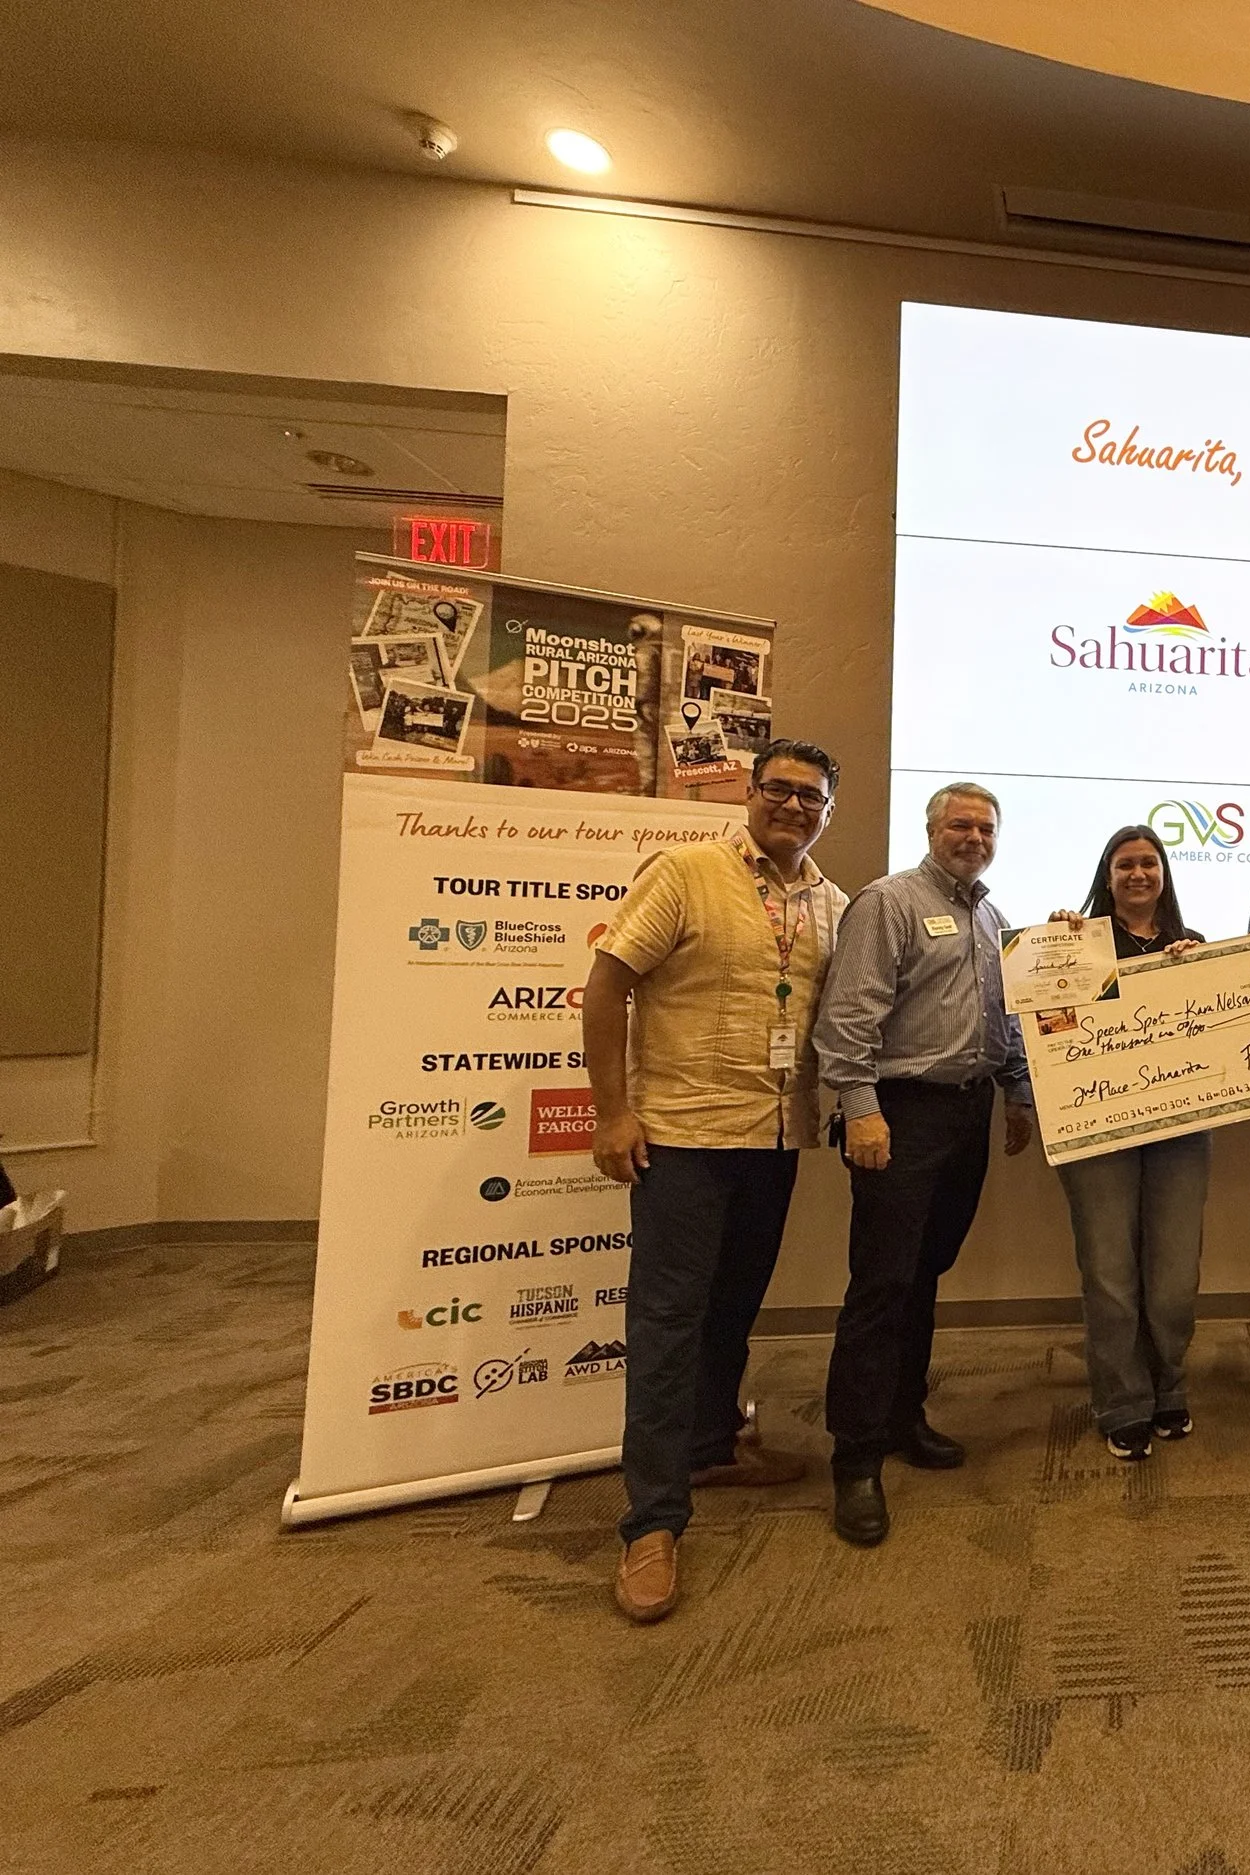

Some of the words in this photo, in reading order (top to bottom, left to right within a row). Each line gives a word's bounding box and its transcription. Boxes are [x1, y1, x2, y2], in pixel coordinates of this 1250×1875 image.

[1071, 419, 1244, 487] Sahuarita,
[411, 521, 476, 564] EXIT
[525, 627, 636, 656] Moonshot
[525, 643, 574, 660] RURAL
[576, 651, 637, 669] ARIZONA
[524, 656, 637, 697] PITCH
[522, 684, 636, 709] COMPETITION
[1128, 682, 1198, 696] ARIZONA
[520, 698, 639, 732] 2025
[674, 764, 721, 778] Prescott,
[723, 761, 738, 772] AZ
[396, 811, 489, 839] Thanks
[497, 819, 518, 839] to
[527, 827, 569, 840] our
[575, 821, 624, 841] tour
[631, 821, 730, 853] sponsors!
[1147, 800, 1245, 849] GVS
[1169, 851, 1212, 862] AMBER
[1216, 852, 1234, 862] OF
[433, 876, 500, 897] TOUR
[507, 880, 571, 900] TITLE
[495, 921, 562, 932] BlueCross
[494, 932, 566, 943] BlueShield
[1031, 934, 1083, 944] CERTIFICATE
[493, 943, 538, 953] Arizona
[487, 1012, 562, 1021] COMMERCE
[1132, 1005, 1170, 1032] Spot
[421, 1052, 562, 1072] STATEWIDE
[380, 1099, 460, 1115] Growth
[537, 1104, 597, 1119] WELLS
[368, 1113, 459, 1129] Partners
[537, 1120, 597, 1135] FARGO
[396, 1129, 459, 1139] ARIZONA
[514, 1187, 563, 1197] Economic
[515, 1179, 552, 1188] Arizona
[422, 1241, 544, 1268] REGIONAL
[517, 1284, 574, 1302] TUCSON
[426, 1297, 483, 1327] cic
[510, 1298, 579, 1318] HISPANIC
[518, 1371, 548, 1384] LAB
[564, 1362, 601, 1377] AWD
[370, 1375, 458, 1403] SBDC
